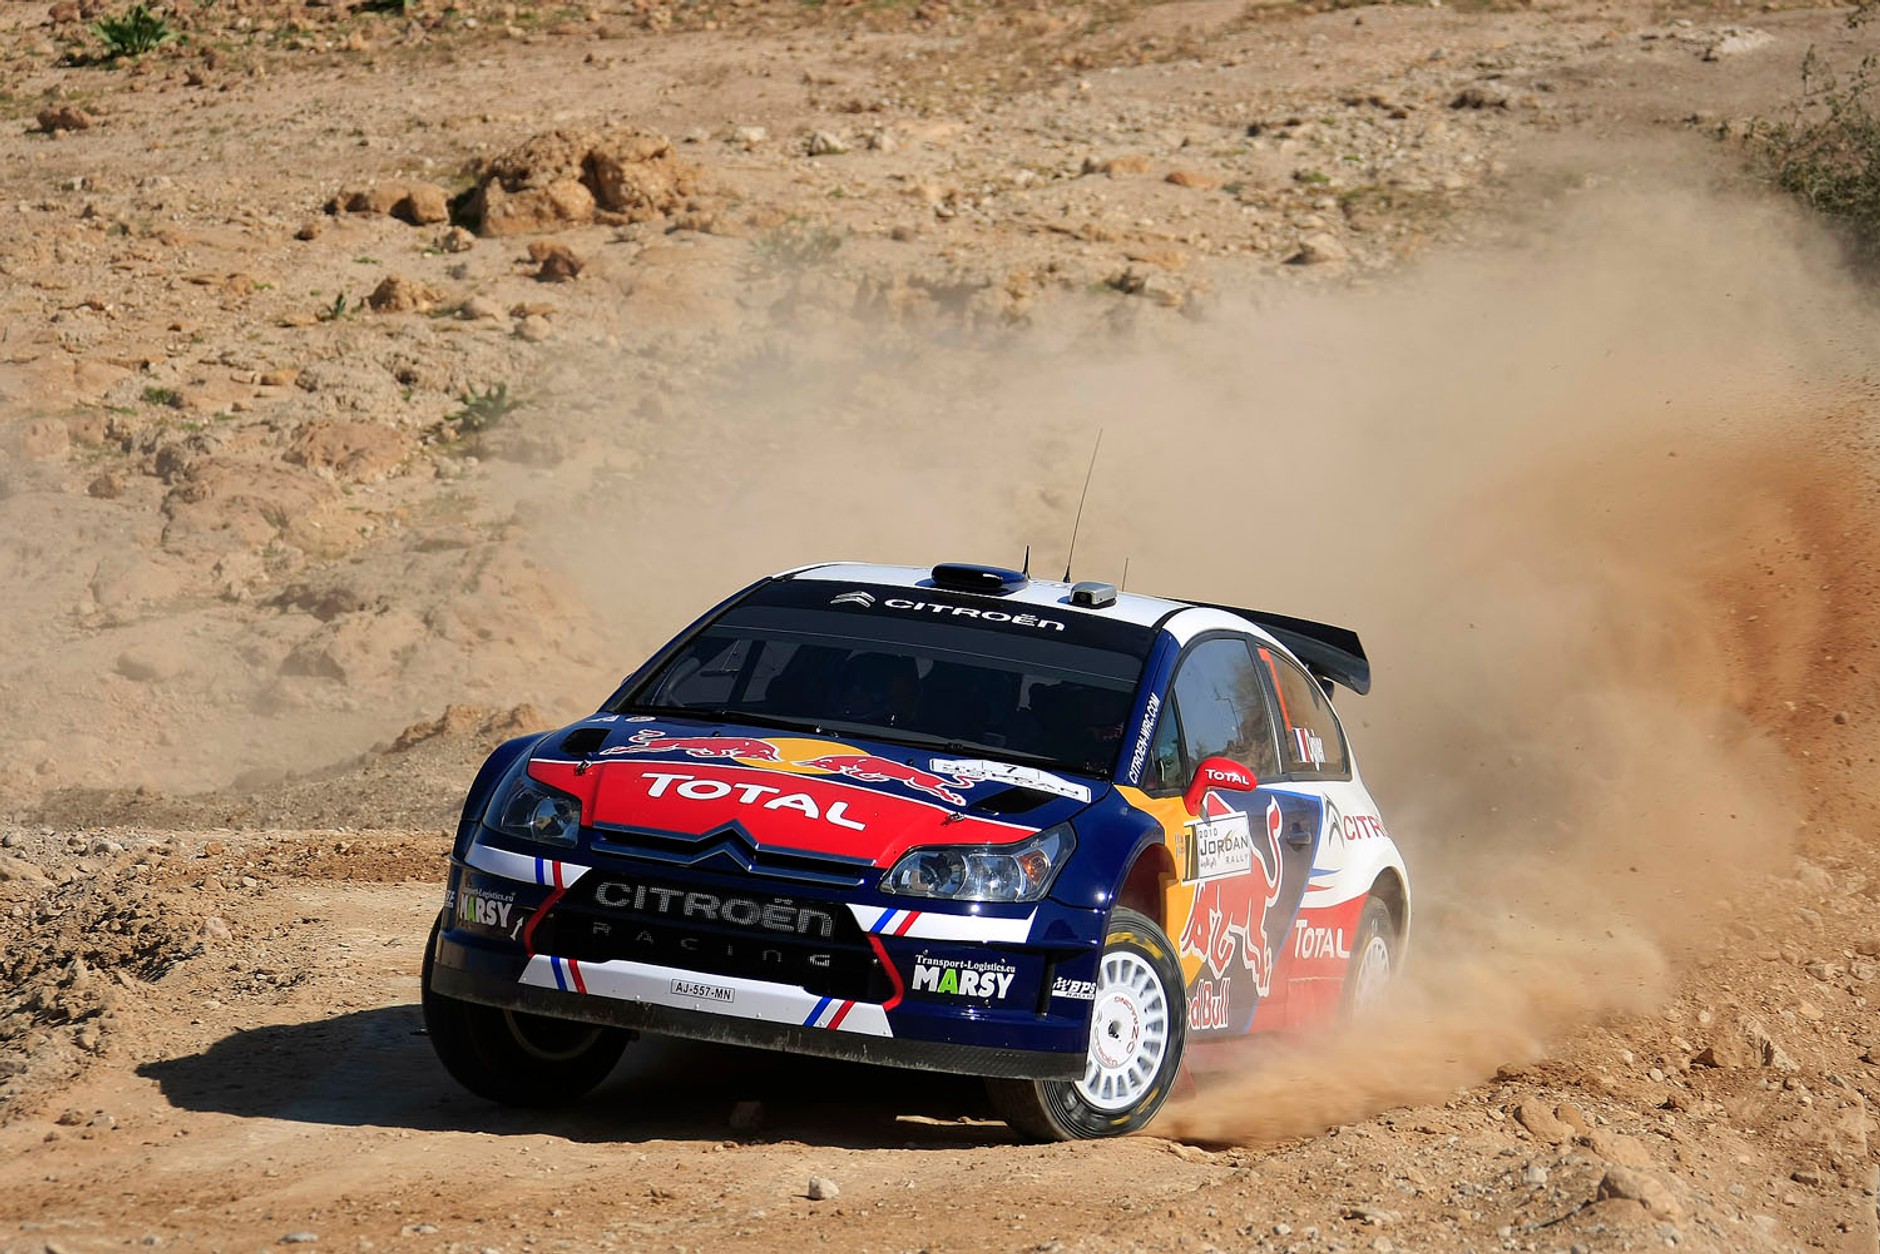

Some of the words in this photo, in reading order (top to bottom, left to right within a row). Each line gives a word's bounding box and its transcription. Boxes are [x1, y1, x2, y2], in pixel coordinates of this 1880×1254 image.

[1128, 691, 1161, 785] CITROEN-WRC.COM
[1003, 764, 1018, 774] 7
[1204, 768, 1250, 786] TOTAL
[641, 772, 867, 831] TOTAL
[1199, 827, 1218, 839] 2010
[1343, 815, 1388, 841] CITR
[1200, 835, 1249, 859] JORDAN
[1225, 853, 1249, 865] RALLY
[460, 893, 512, 928] MARSY
[1294, 919, 1351, 959] TOTAL
[915, 955, 1016, 974] Transport-Logistics.eu
[675, 981, 732, 1001] AJ-557-MN
[912, 965, 1015, 999] MARSY
[1067, 980, 1097, 994] BPS
[1201, 977, 1231, 1030] Bull
